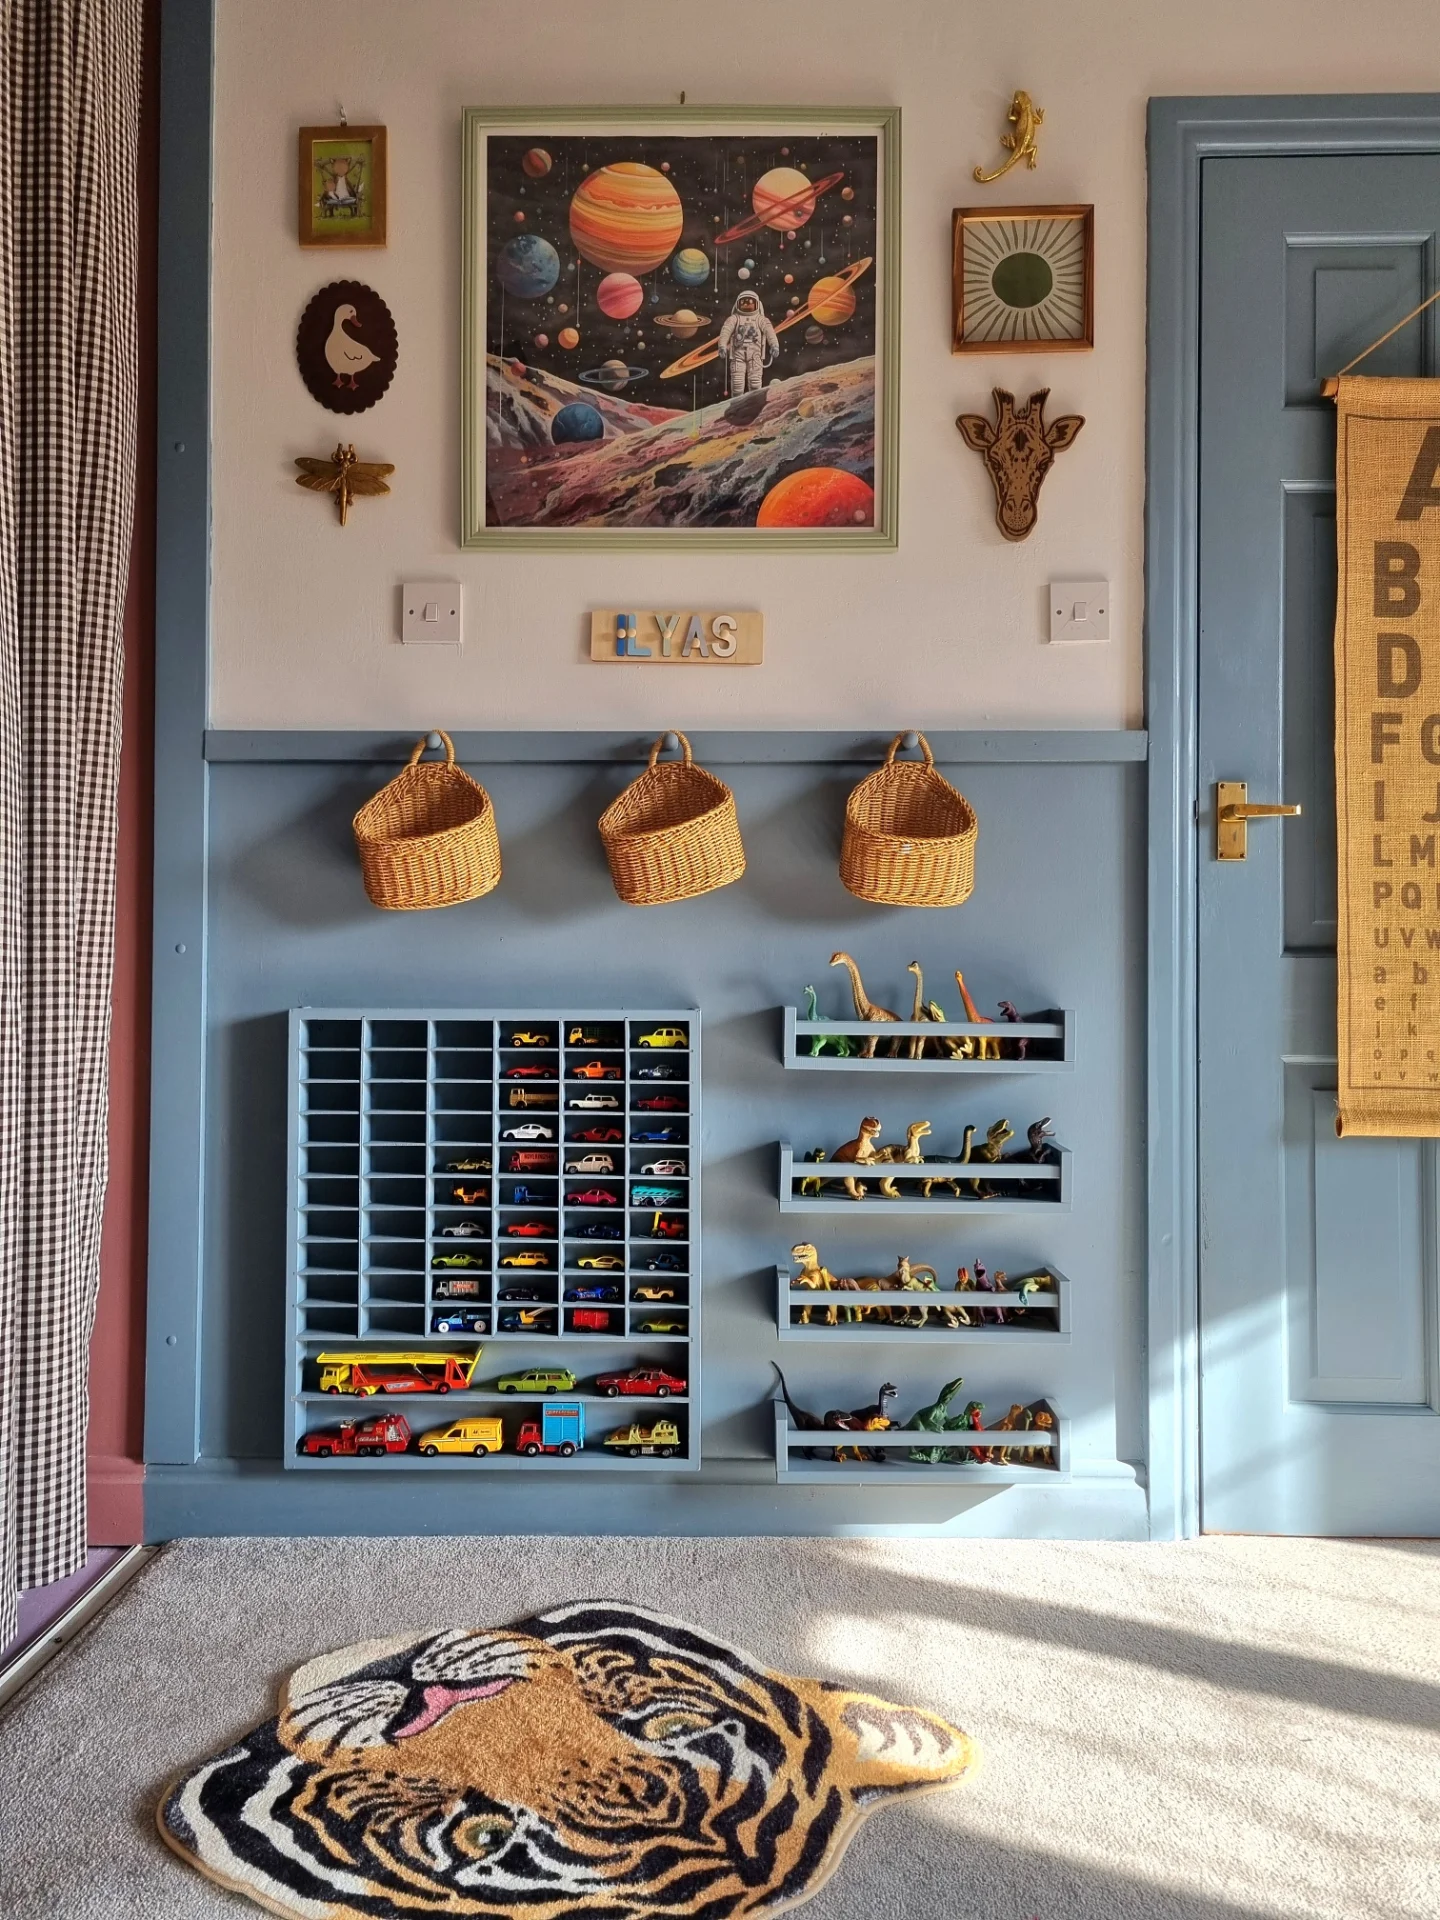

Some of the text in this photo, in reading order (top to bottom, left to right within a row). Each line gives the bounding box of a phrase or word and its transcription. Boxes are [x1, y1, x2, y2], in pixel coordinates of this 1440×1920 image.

[1395, 426, 1440, 520] A
[1373, 540, 1421, 618] B
[616, 613, 738, 658] ILYAS
[1377, 632, 1421, 698] D
[1371, 712, 1402, 763] F
